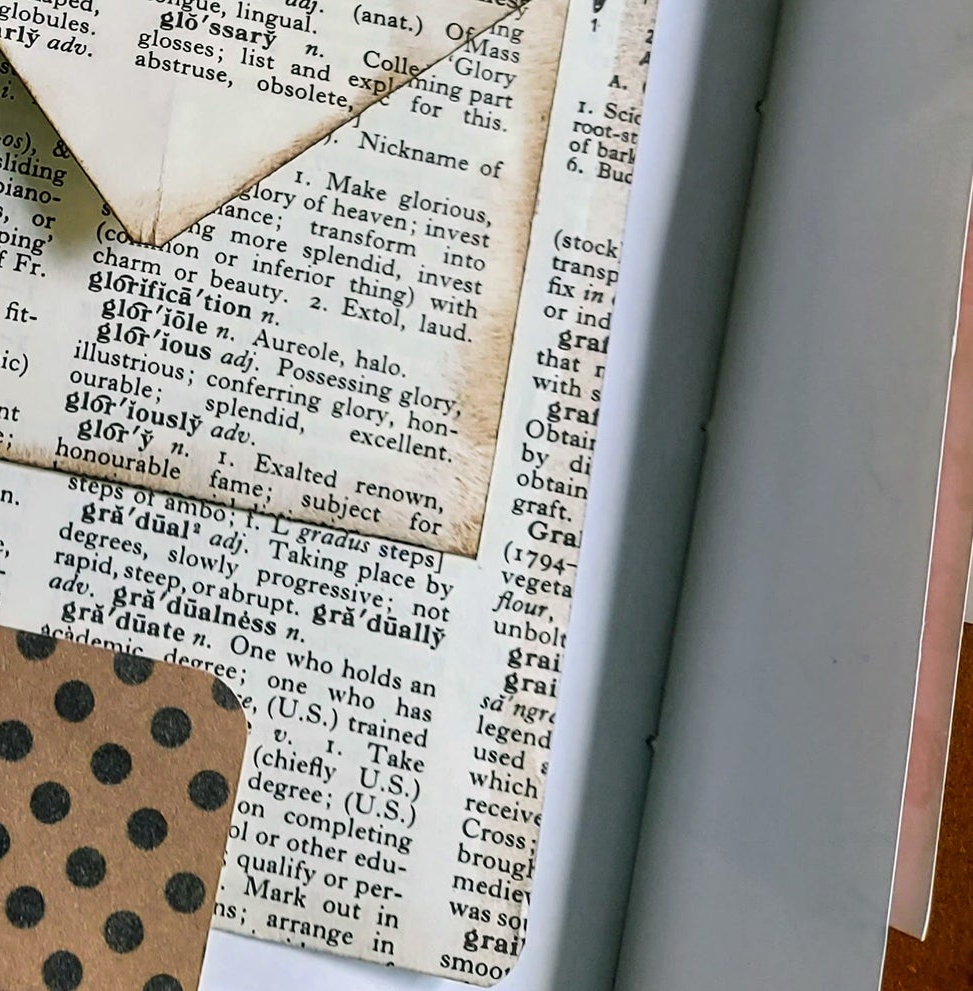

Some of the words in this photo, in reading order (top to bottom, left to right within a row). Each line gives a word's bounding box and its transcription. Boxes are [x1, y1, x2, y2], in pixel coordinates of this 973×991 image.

[353, 3, 424, 38] (anat.)
[134, 50, 234, 89] abstruse,
[256, 75, 354, 114] obsolete,
[357, 130, 470, 172] Nickname
[479, 160, 505, 180] of
[325, 171, 388, 202] Make
[397, 190, 492, 229] glorious,
[12, 252, 46, 278] Fr.
[536, 347, 581, 374] that
[205, 374, 323, 414] conferring
[330, 396, 395, 429] glory,
[407, 409, 459, 438] hon-
[531, 375, 582, 399] with
[205, 396, 305, 435] splendid,
[349, 429, 453, 464] excellent.
[54, 435, 182, 481] honourable
[300, 492, 382, 524] subject
[408, 511, 443, 537] for
[510, 497, 573, 523] graft.
[58, 520, 149, 562] degrees,
[167, 544, 240, 581] slowly
[411, 602, 451, 623] not
[267, 674, 308, 695] one
[327, 685, 376, 711] who
[394, 696, 433, 723] has
[267, 695, 339, 733] (U.S.)
[348, 716, 429, 749] trained
[255, 830, 281, 848] or
[285, 835, 348, 863] other
[354, 850, 407, 875] edu-
[283, 810, 414, 856] completing
